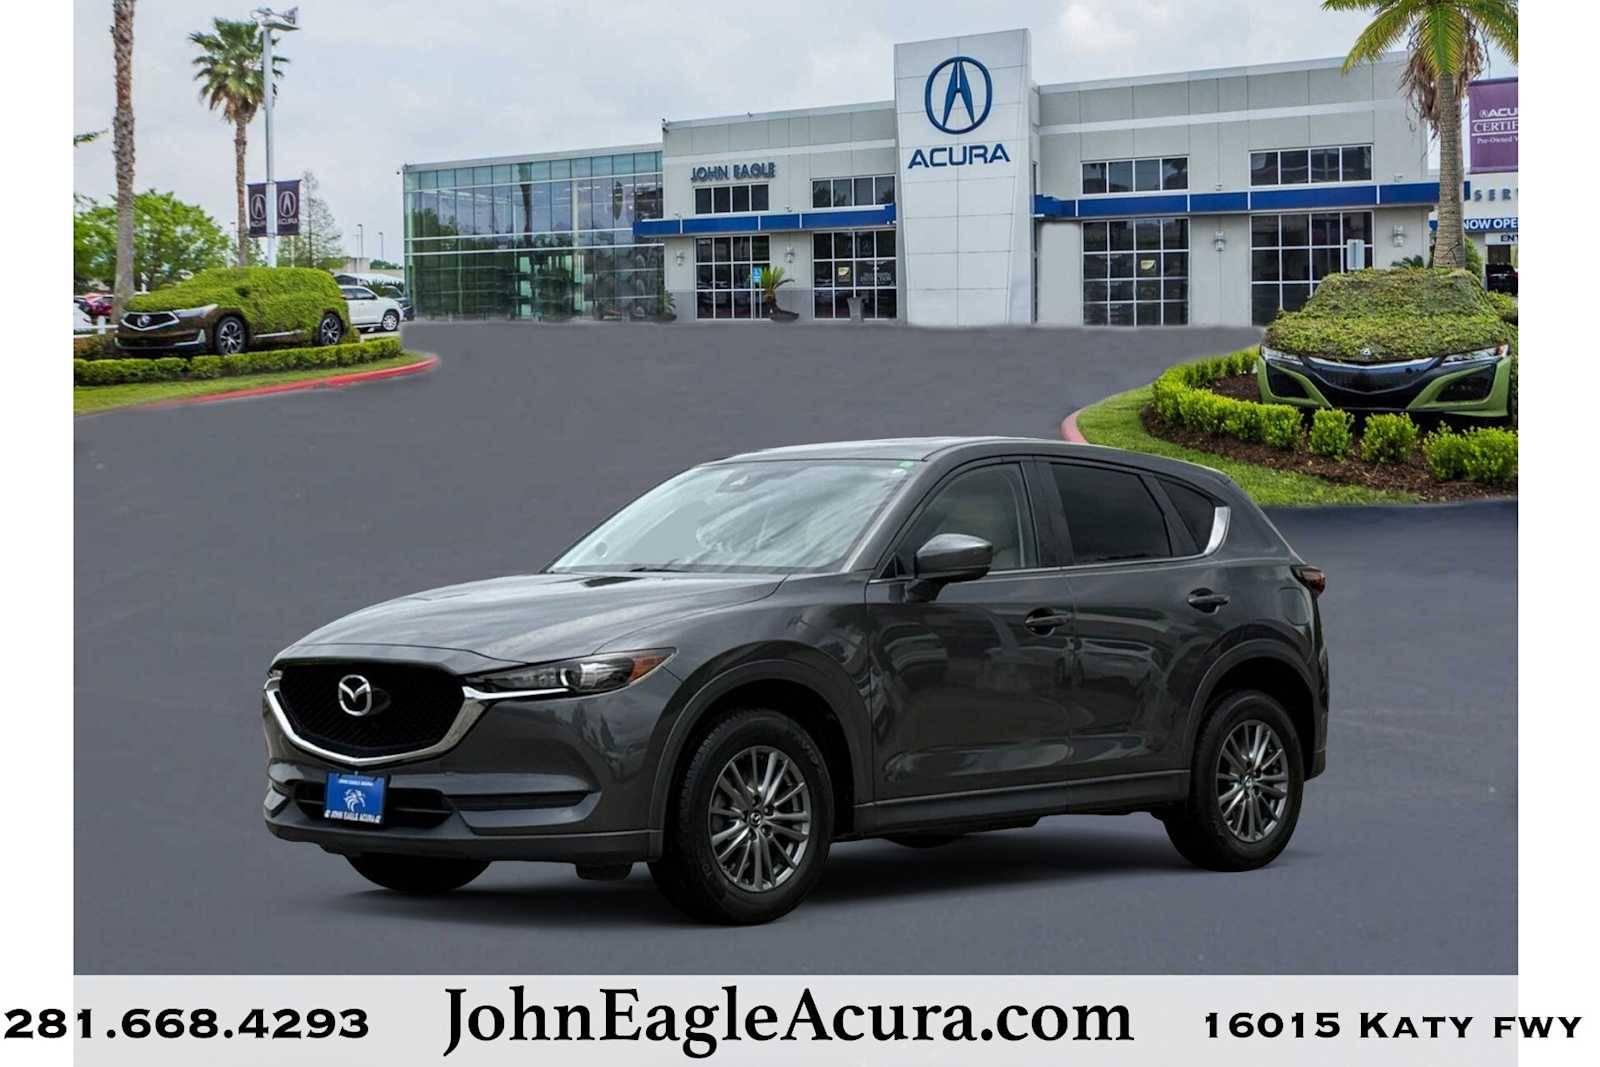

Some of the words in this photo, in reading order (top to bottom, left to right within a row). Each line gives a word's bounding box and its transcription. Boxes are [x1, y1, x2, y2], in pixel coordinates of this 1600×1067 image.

[908, 143, 1011, 169] ACURA
[690, 164, 729, 181] JOHN
[732, 161, 777, 179] EAGLE
[1473, 187, 1518, 202] SER
